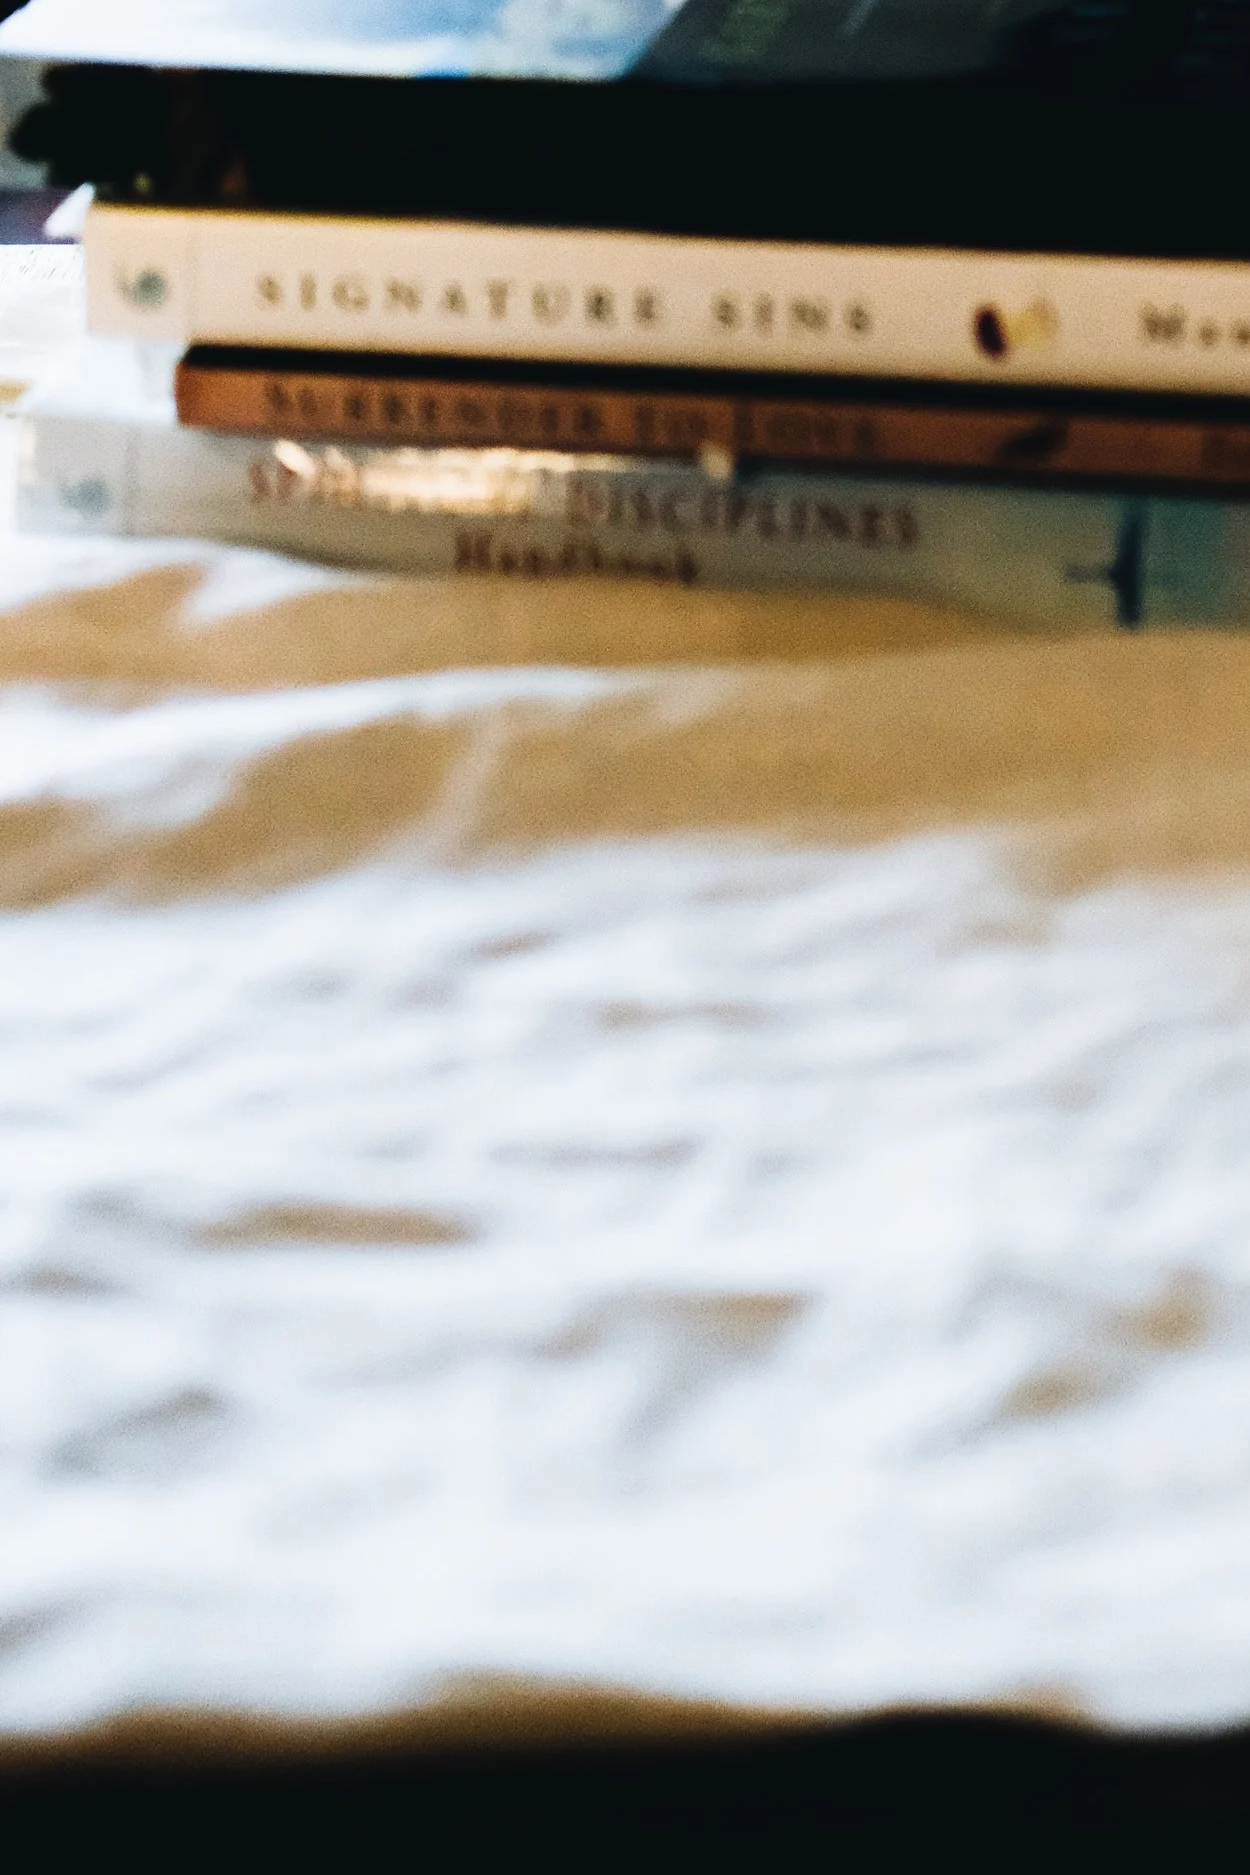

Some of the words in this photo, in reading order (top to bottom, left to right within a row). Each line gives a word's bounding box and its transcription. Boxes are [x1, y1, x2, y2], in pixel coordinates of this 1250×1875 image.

[256, 267, 664, 329] SIGNATURE
[711, 291, 876, 339] SINS
[568, 477, 918, 547] DISCIPLINES
